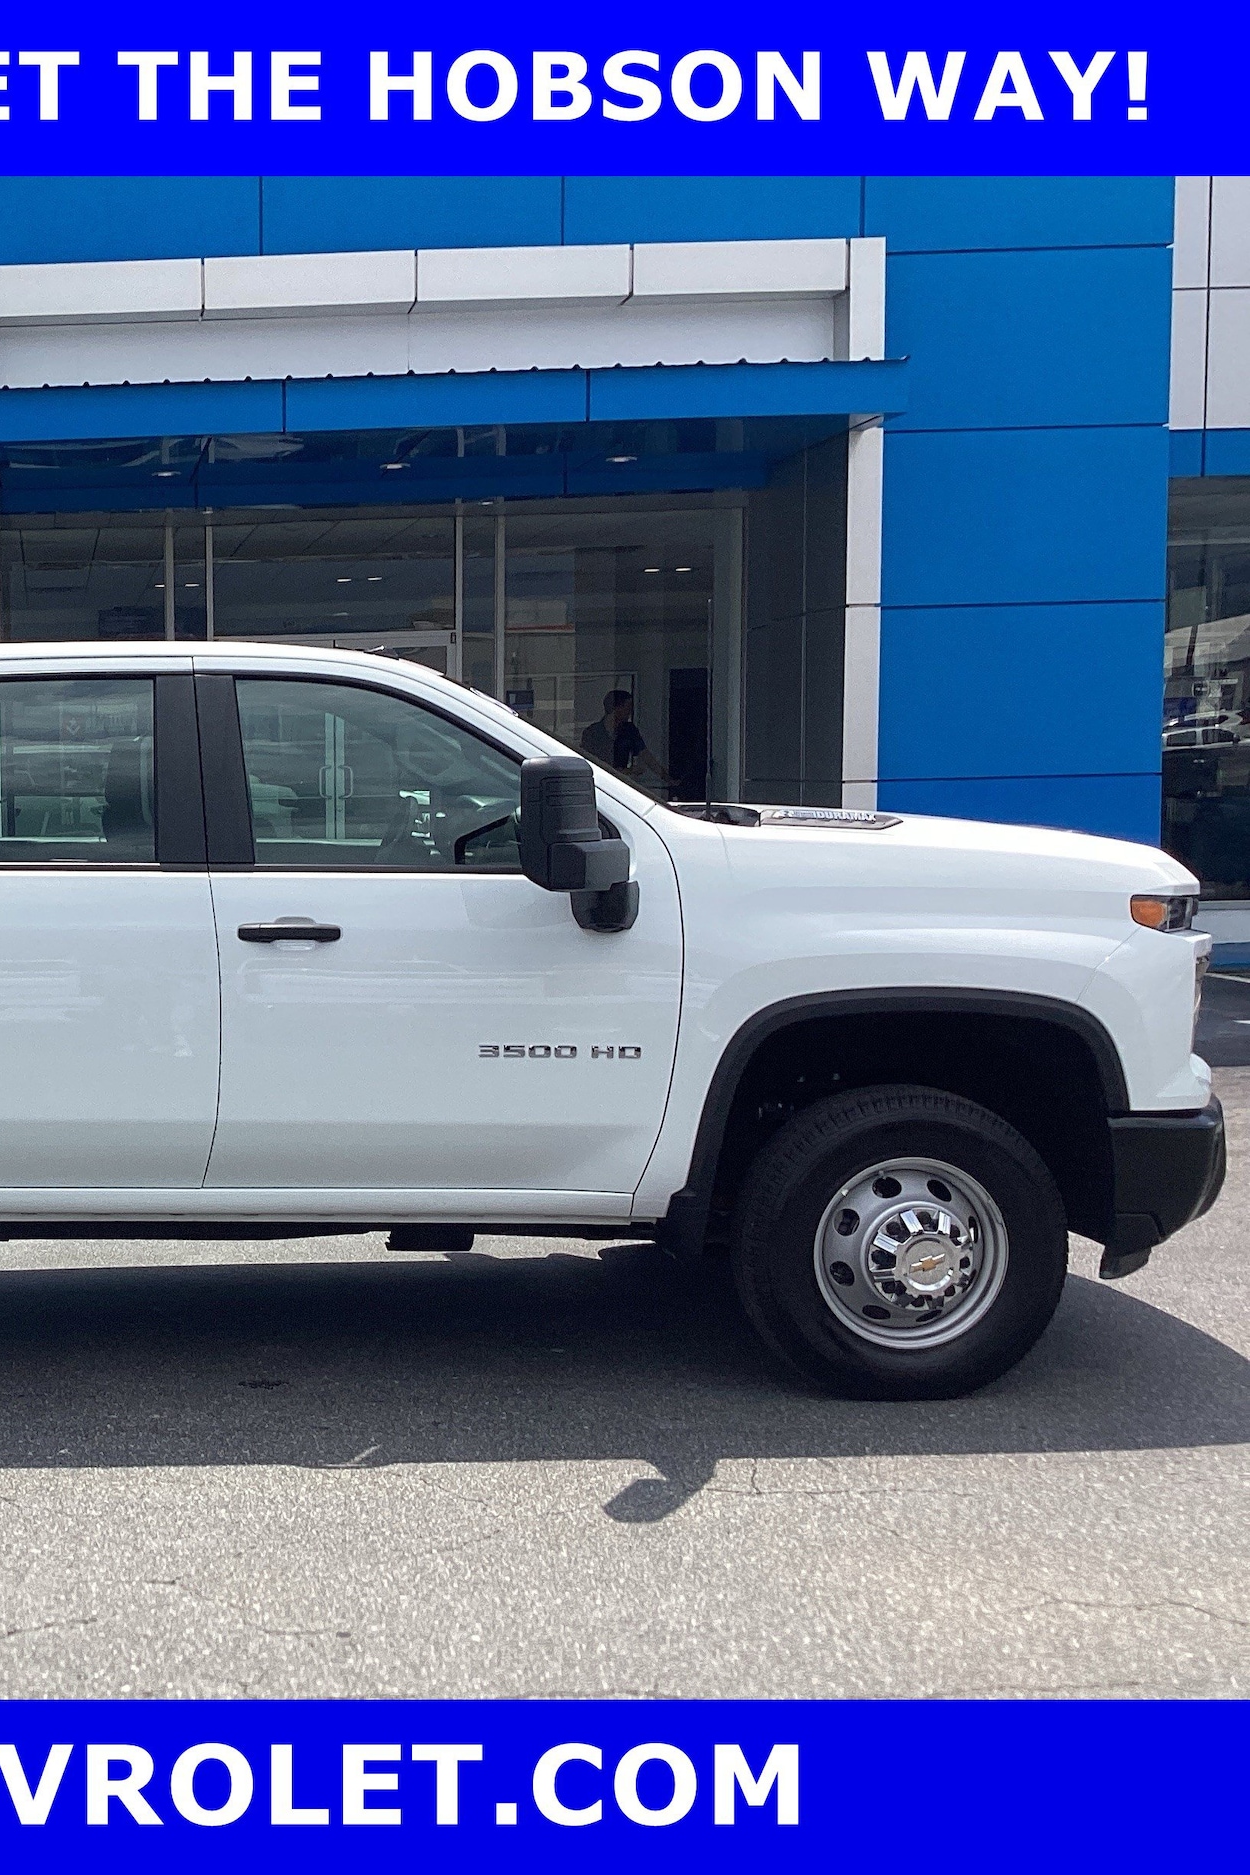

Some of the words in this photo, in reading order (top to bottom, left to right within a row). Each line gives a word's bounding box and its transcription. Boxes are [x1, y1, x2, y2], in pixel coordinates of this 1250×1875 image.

[814, 811, 876, 821] DURAMAX
[478, 1045, 578, 1059] 3500
[591, 1045, 642, 1059] HD
